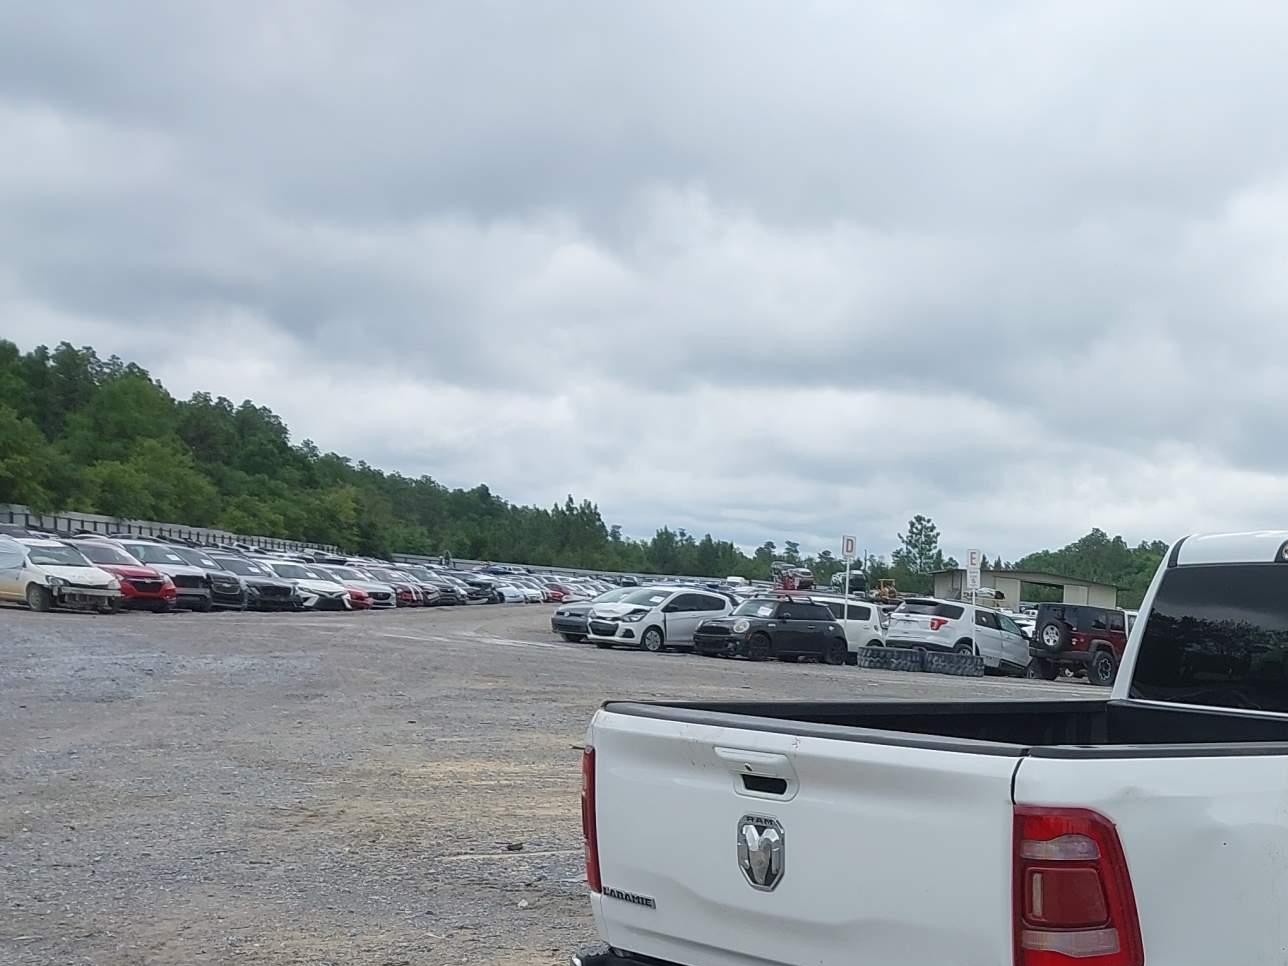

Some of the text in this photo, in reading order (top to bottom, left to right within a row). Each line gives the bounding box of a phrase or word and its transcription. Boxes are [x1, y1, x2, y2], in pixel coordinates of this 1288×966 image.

[845, 538, 854, 553] D
[970, 551, 977, 566] E
[745, 816, 774, 825] RAM
